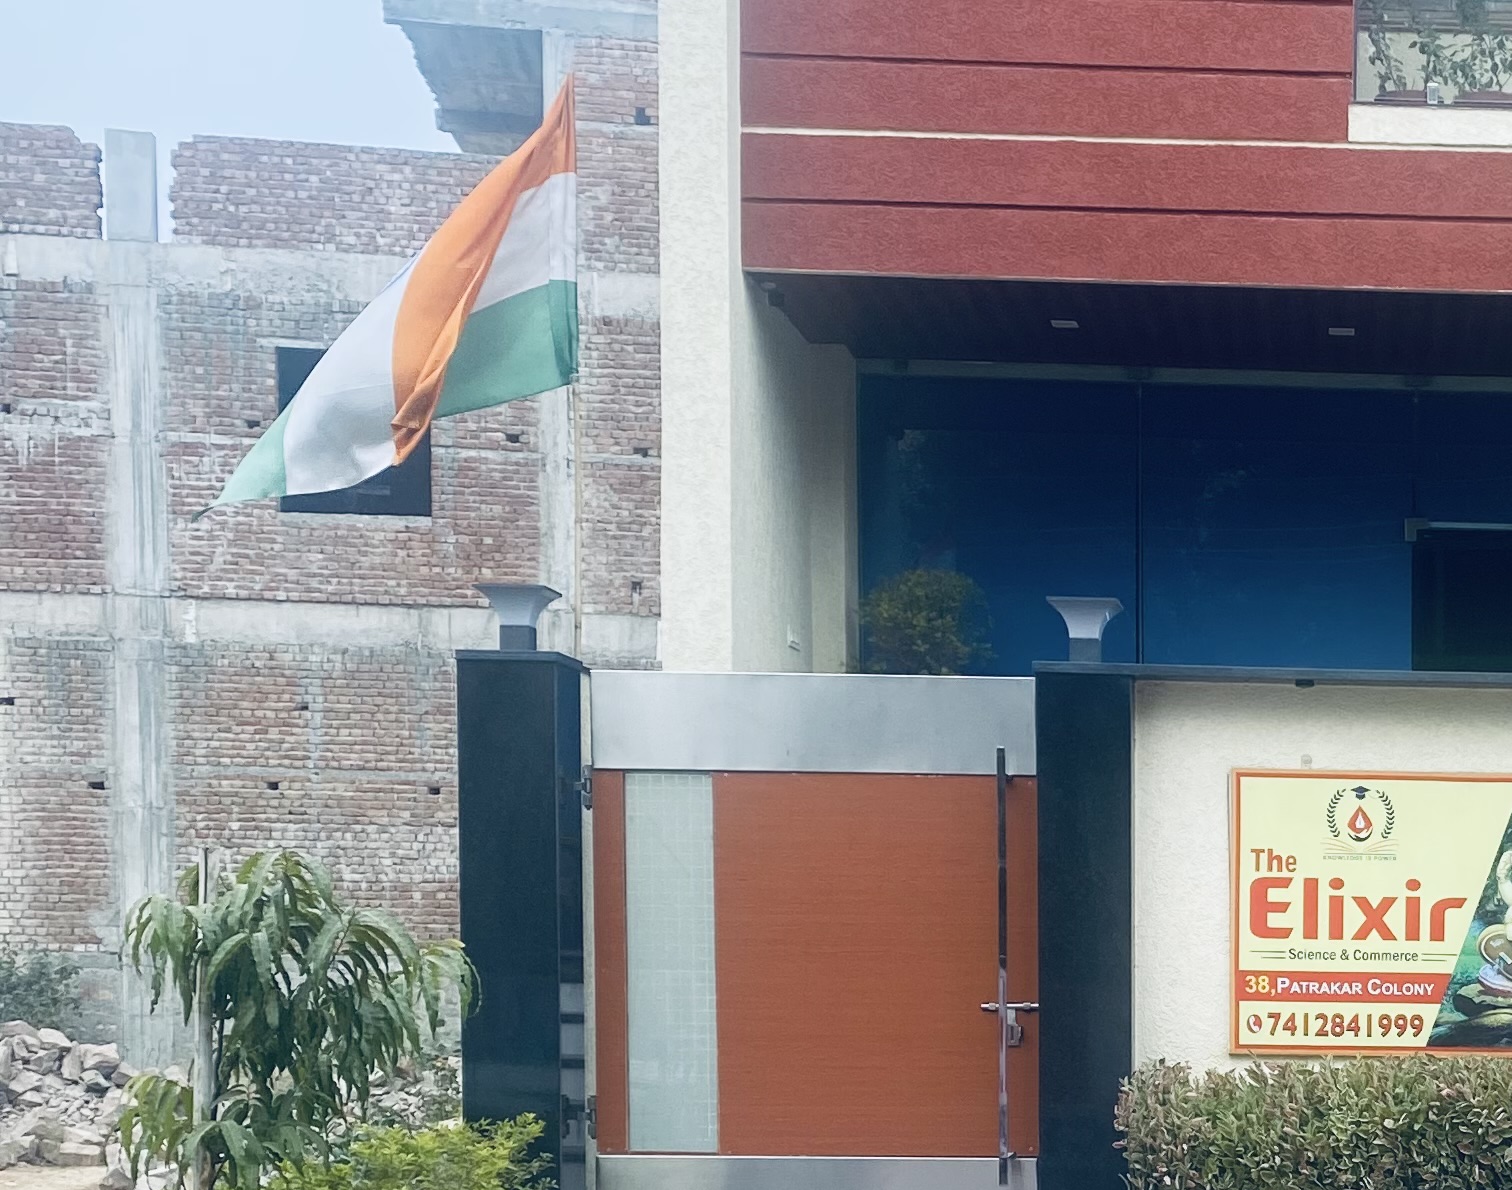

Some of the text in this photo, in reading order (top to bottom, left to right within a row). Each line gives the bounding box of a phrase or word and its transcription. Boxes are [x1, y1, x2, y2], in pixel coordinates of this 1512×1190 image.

[1250, 848, 1297, 873] The
[1249, 876, 1468, 942] Elixir
[1288, 948, 1419, 962] Science & Commerce
[1367, 978, 1435, 996] COLONY
[1267, 1012, 1424, 1038] 7412841999
